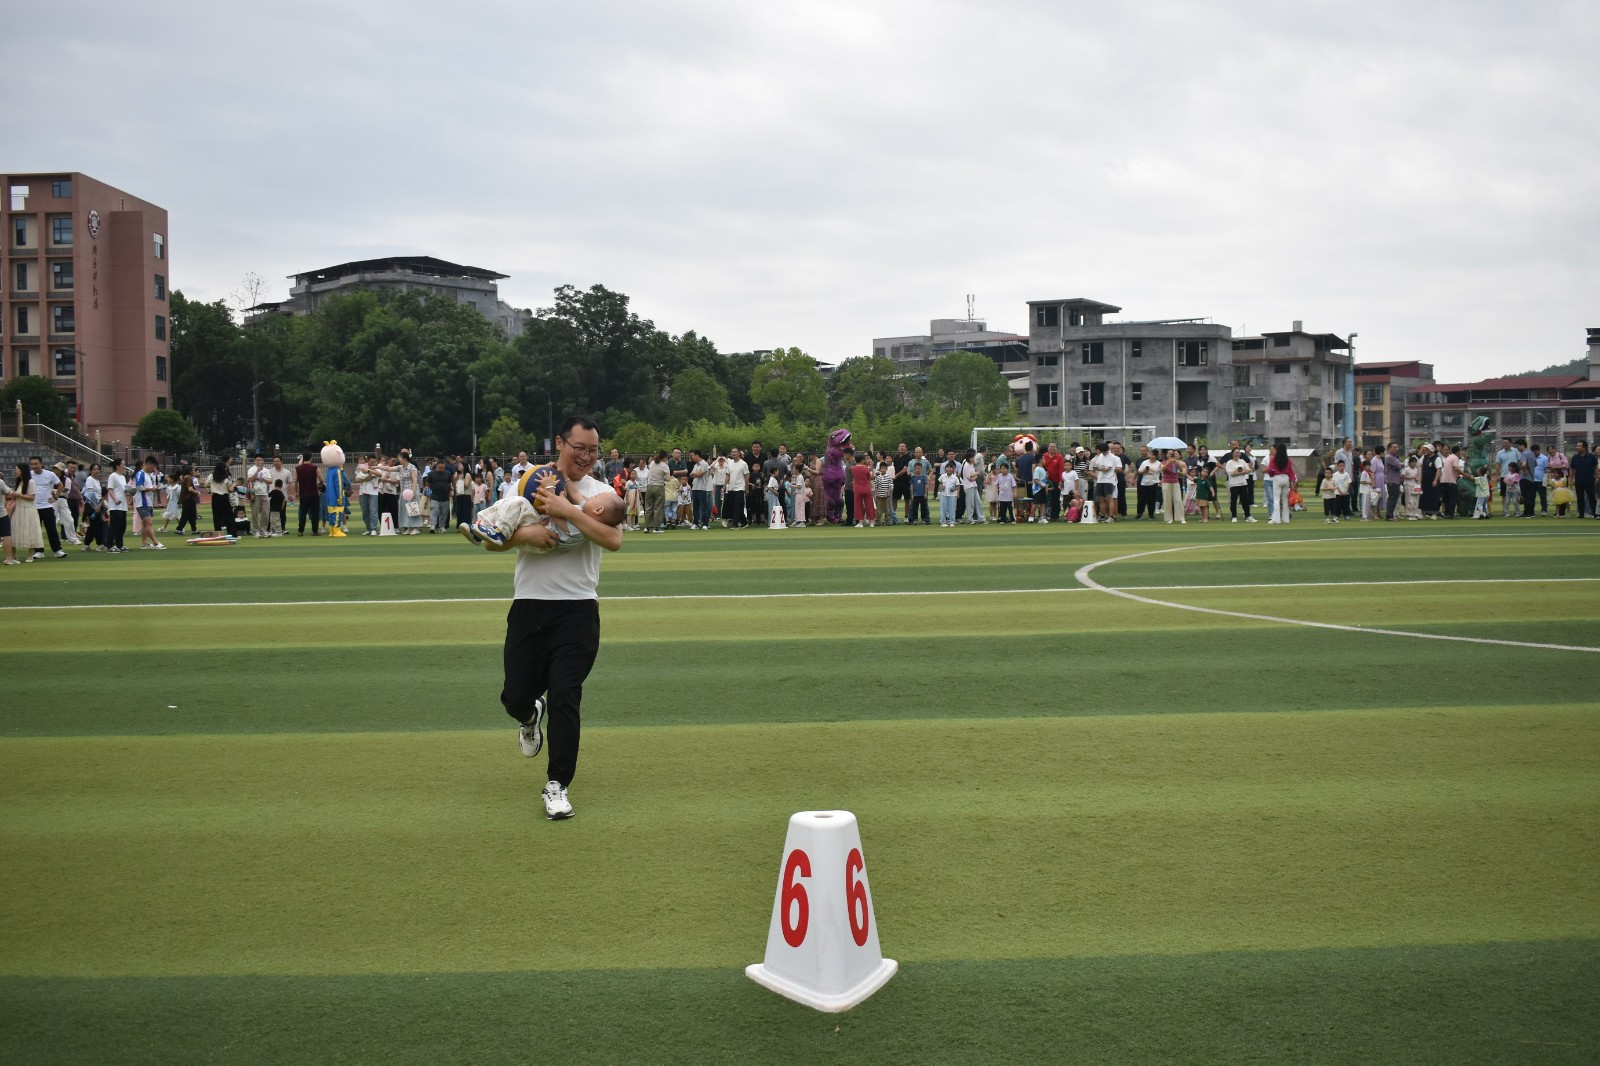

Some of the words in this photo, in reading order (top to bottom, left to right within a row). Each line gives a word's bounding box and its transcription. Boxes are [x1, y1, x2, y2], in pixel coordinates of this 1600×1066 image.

[771, 510, 776, 524] 2
[780, 510, 785, 524] 2
[1083, 505, 1089, 518] 3
[384, 516, 390, 530] 1
[781, 849, 812, 948] 6
[845, 848, 869, 947] 6
